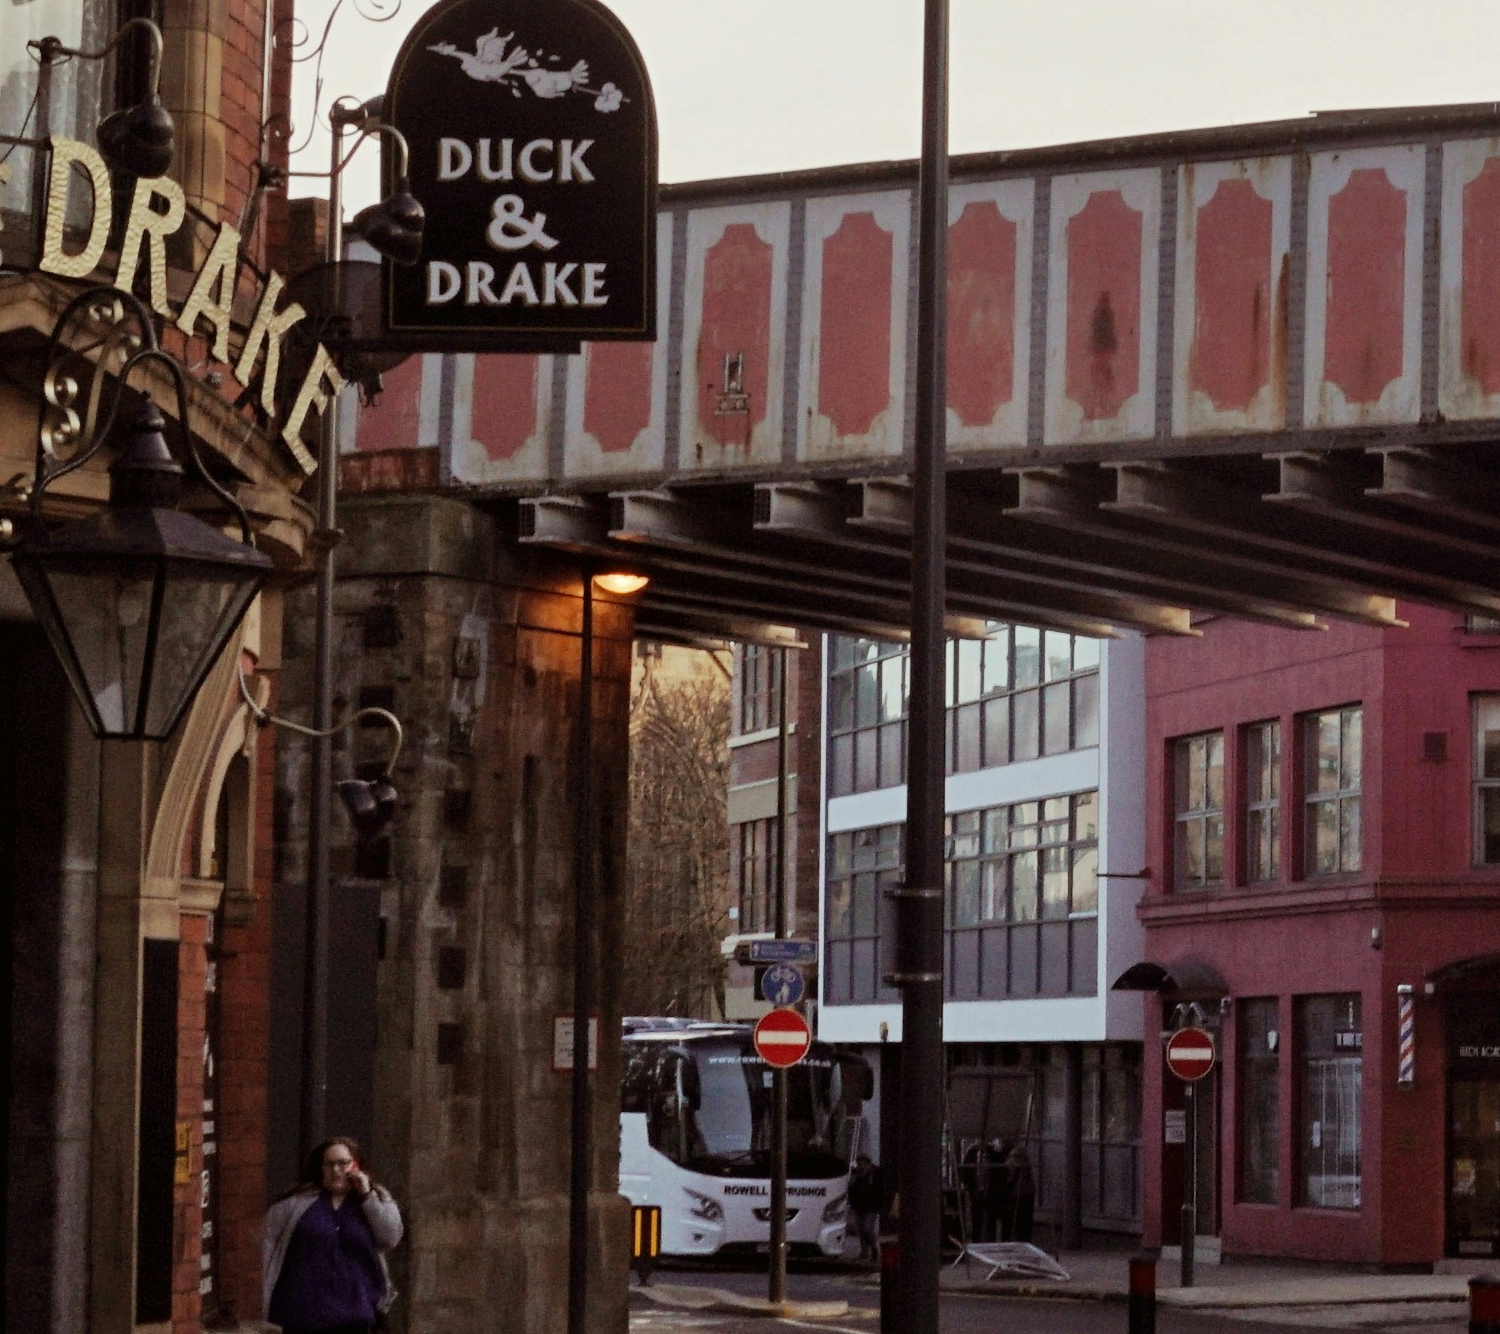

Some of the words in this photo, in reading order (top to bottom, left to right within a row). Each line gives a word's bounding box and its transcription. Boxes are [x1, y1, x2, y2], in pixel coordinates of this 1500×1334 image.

[437, 137, 596, 183] DUCK
[487, 193, 560, 251] &
[39, 134, 346, 476] DRAKE
[426, 260, 610, 305] DRAKE
[724, 1185, 768, 1196] ROWELL
